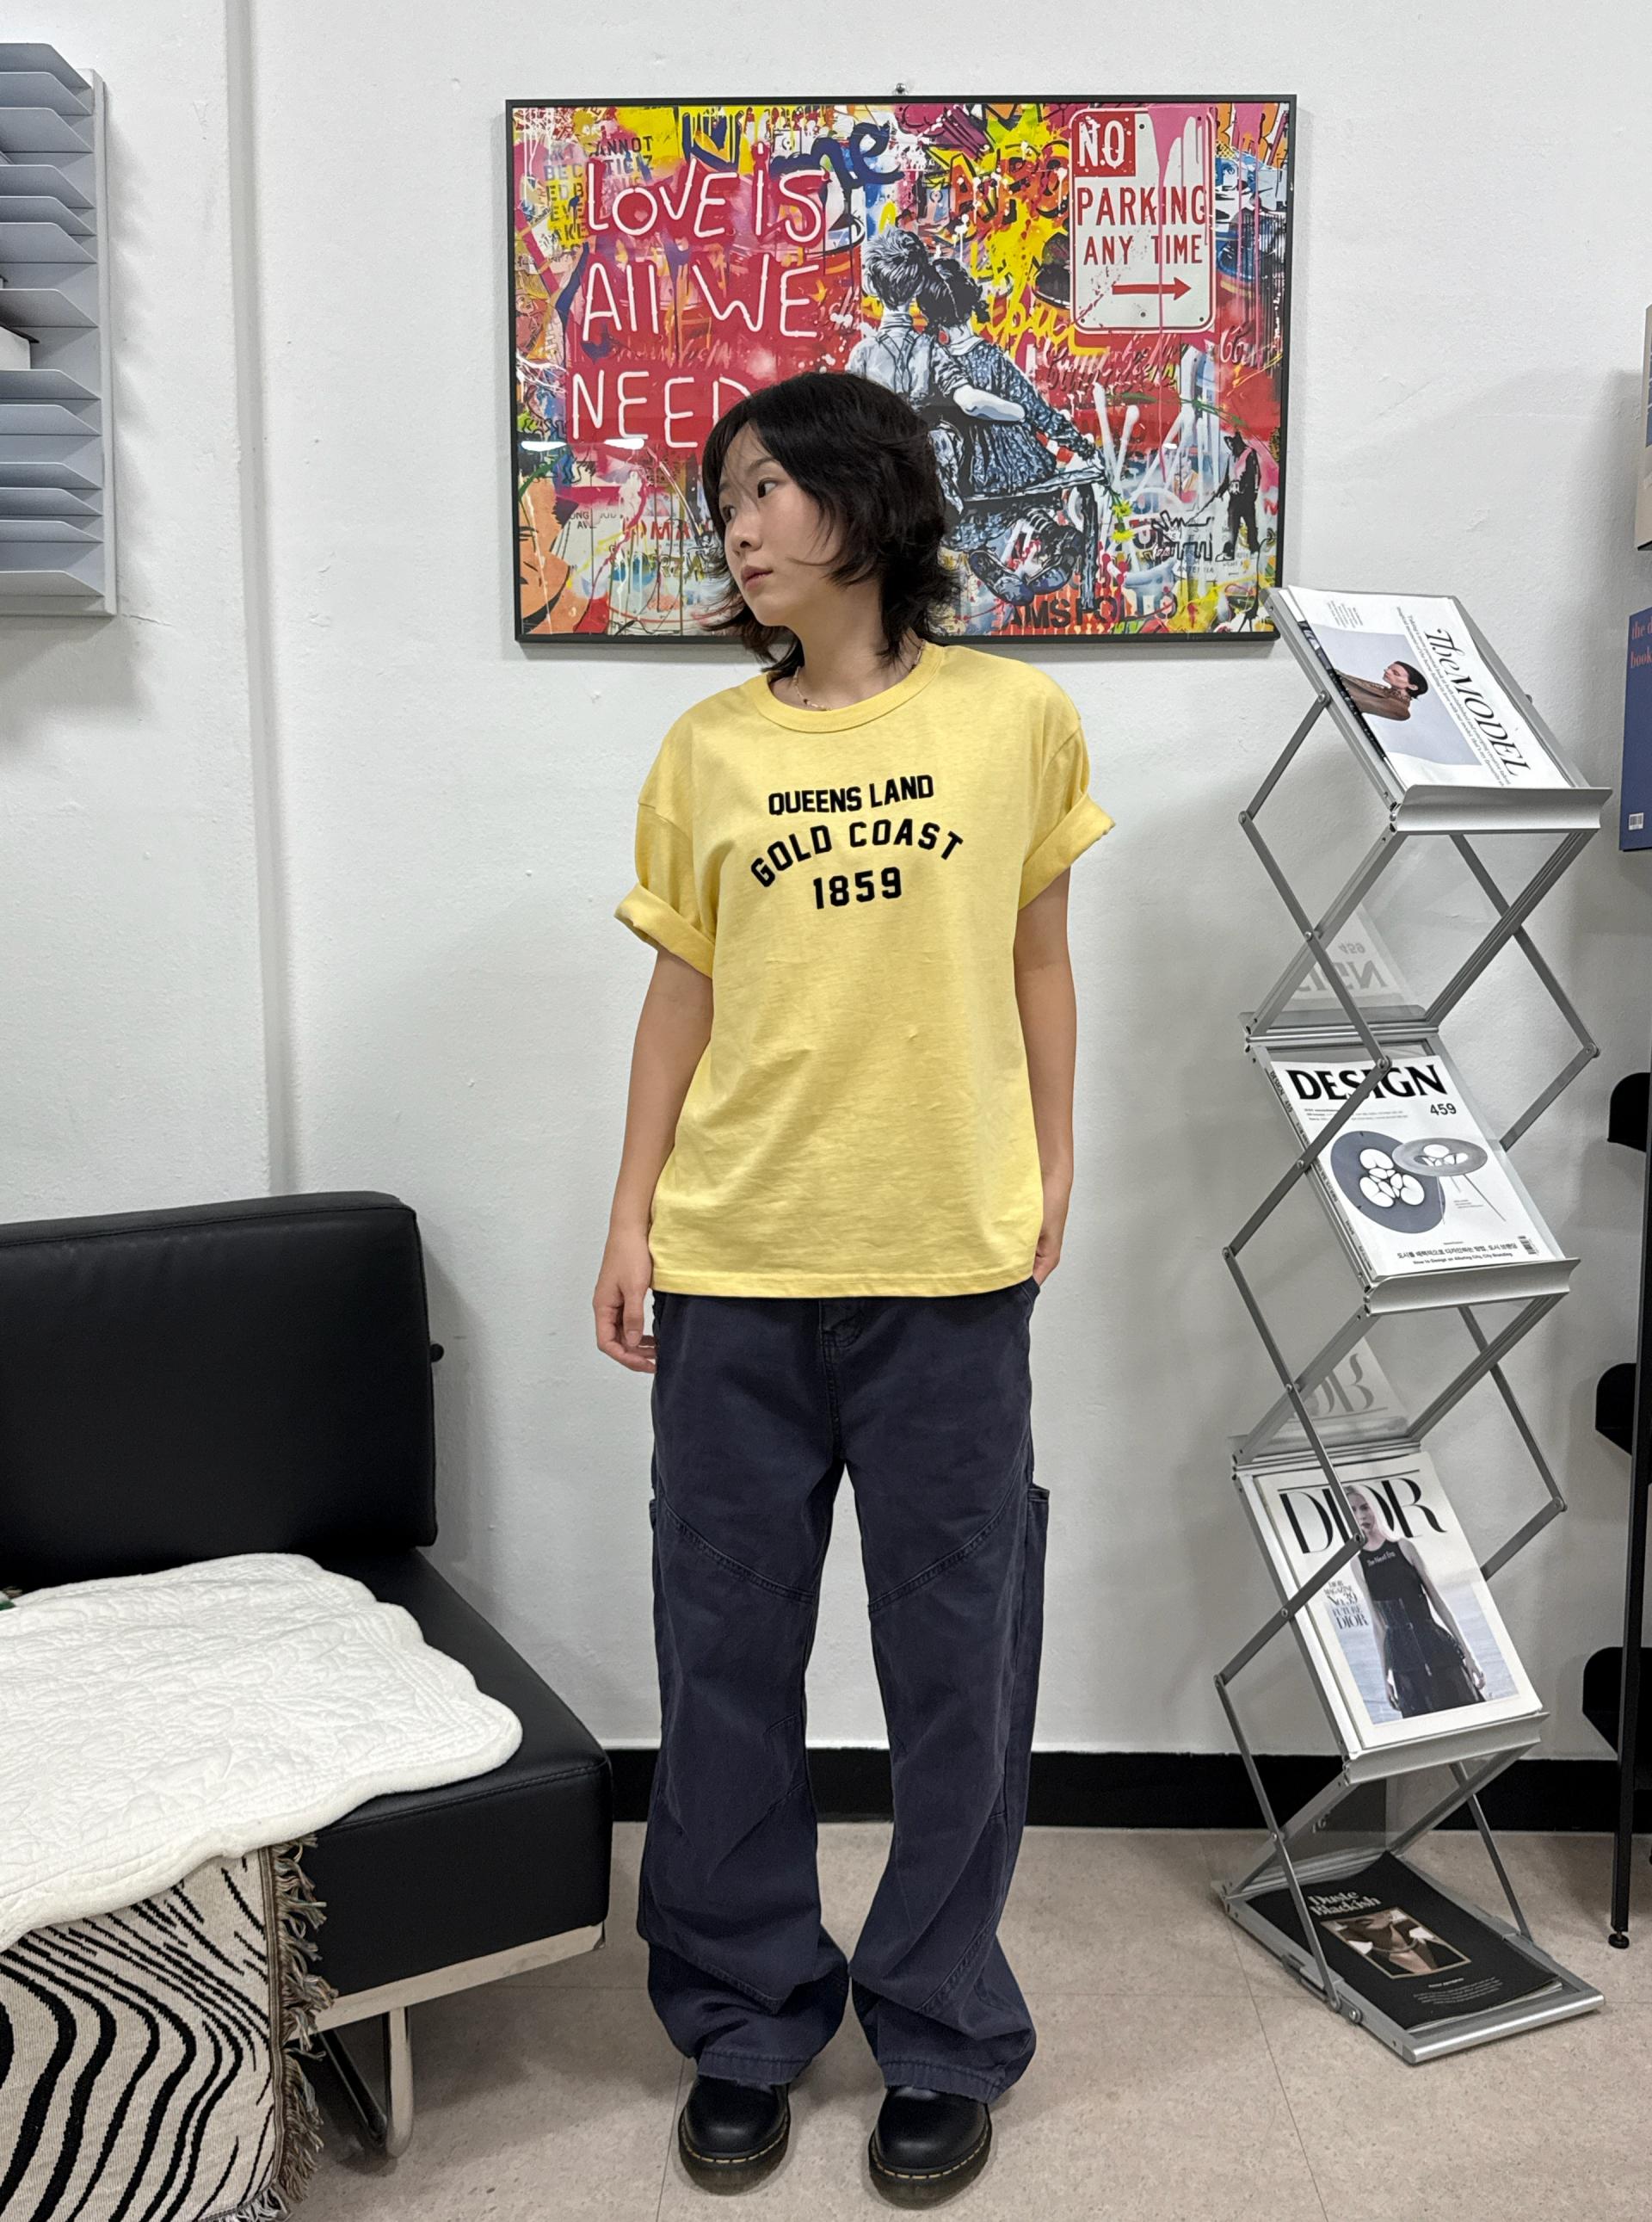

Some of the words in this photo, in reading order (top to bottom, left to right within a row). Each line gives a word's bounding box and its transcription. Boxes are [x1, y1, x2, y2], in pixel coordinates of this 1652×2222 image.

[1078, 119, 1125, 168] NO
[588, 157, 738, 238] LOVE
[755, 143, 827, 243] IS
[1077, 184, 1206, 226] PARKING
[1082, 235, 1133, 265] ANY
[1150, 234, 1203, 265] TIME
[693, 253, 820, 338] WE
[768, 787, 862, 816] QUEENS
[869, 775, 934, 808] LAND
[750, 824, 833, 887] GOLD
[849, 818, 964, 861] COAST
[813, 867, 902, 910] 1859
[1430, 1102, 1457, 1116] 459
[1336, 1614, 1369, 1629] DIOR
